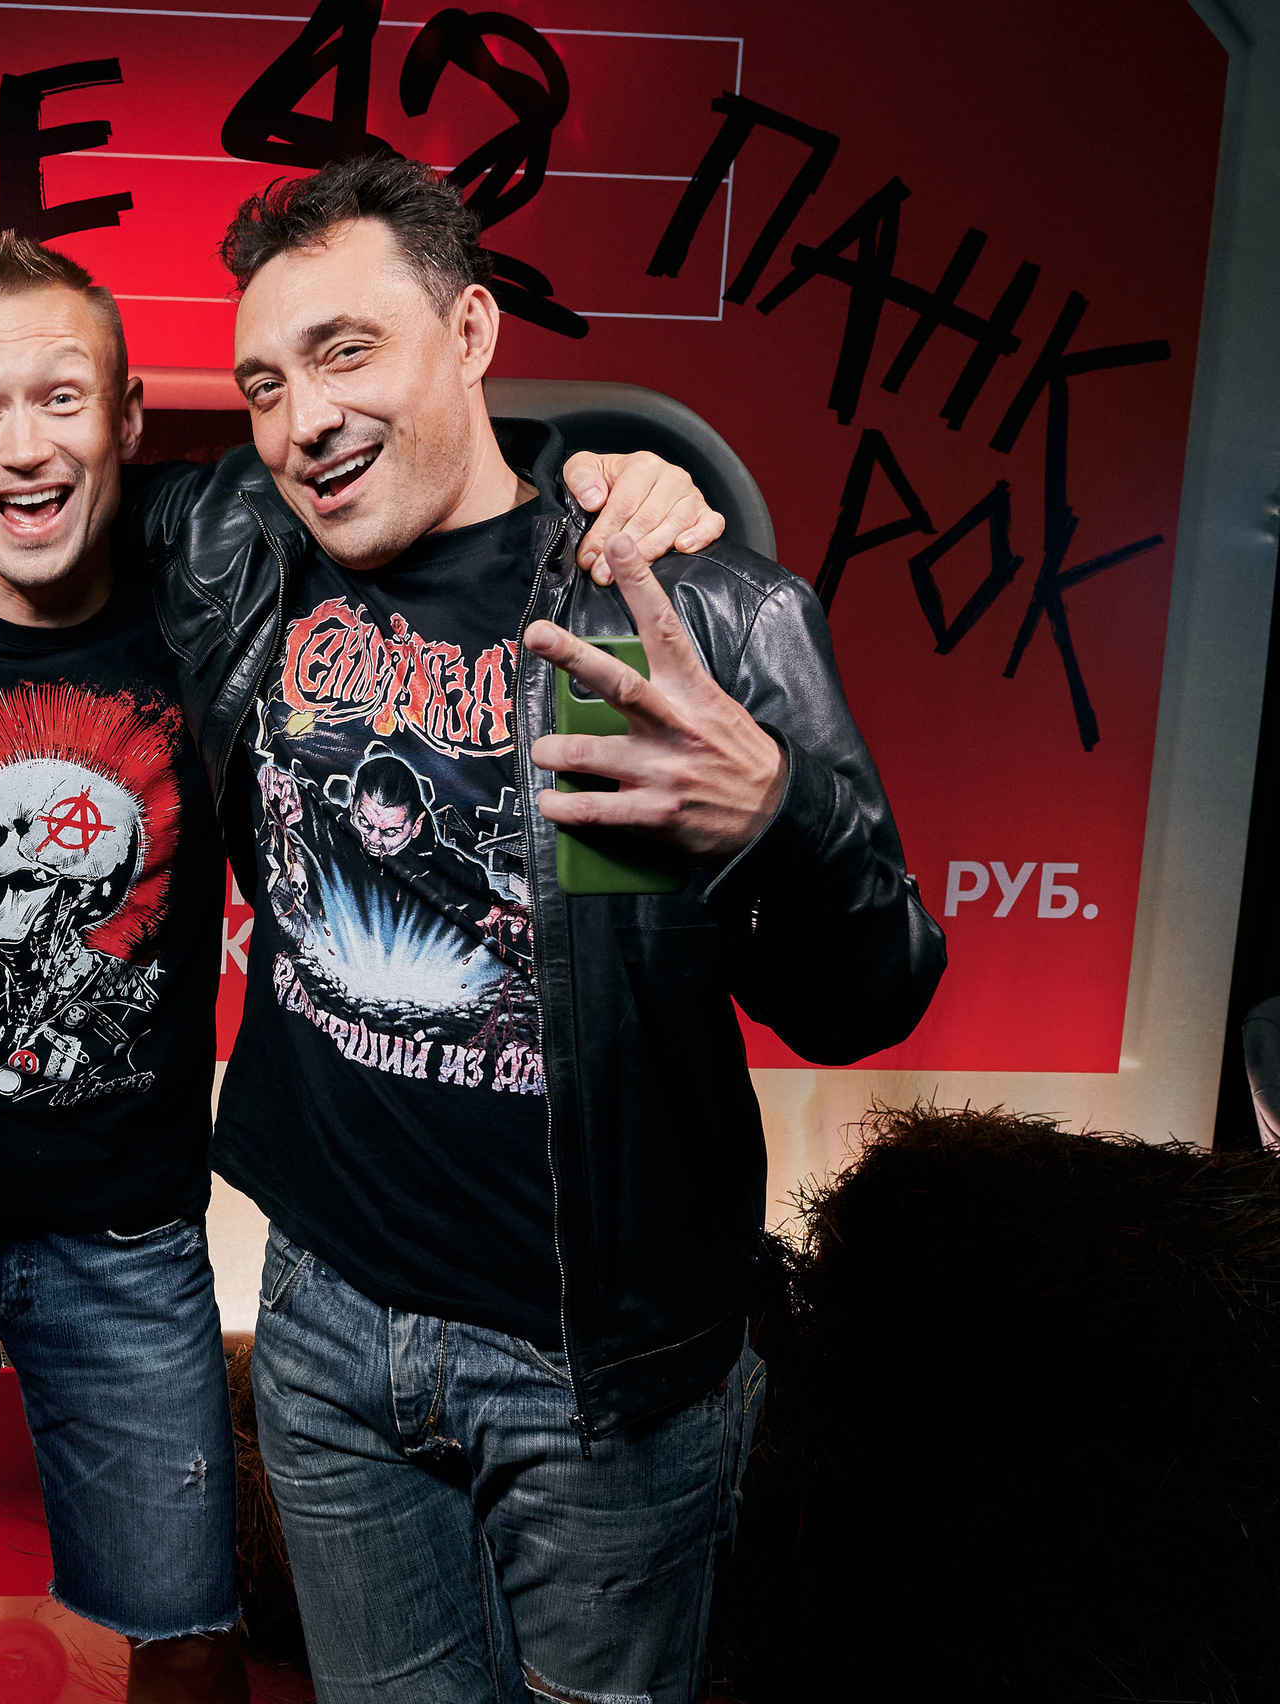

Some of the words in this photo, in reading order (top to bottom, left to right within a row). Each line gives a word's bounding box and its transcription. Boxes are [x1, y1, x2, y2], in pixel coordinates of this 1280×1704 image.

[645, 91, 1172, 515] ПАНК
[812, 428, 1165, 753] РОК
[944, 861, 1099, 920] РУБ.
[437, 1044, 486, 1088] ИЗ
